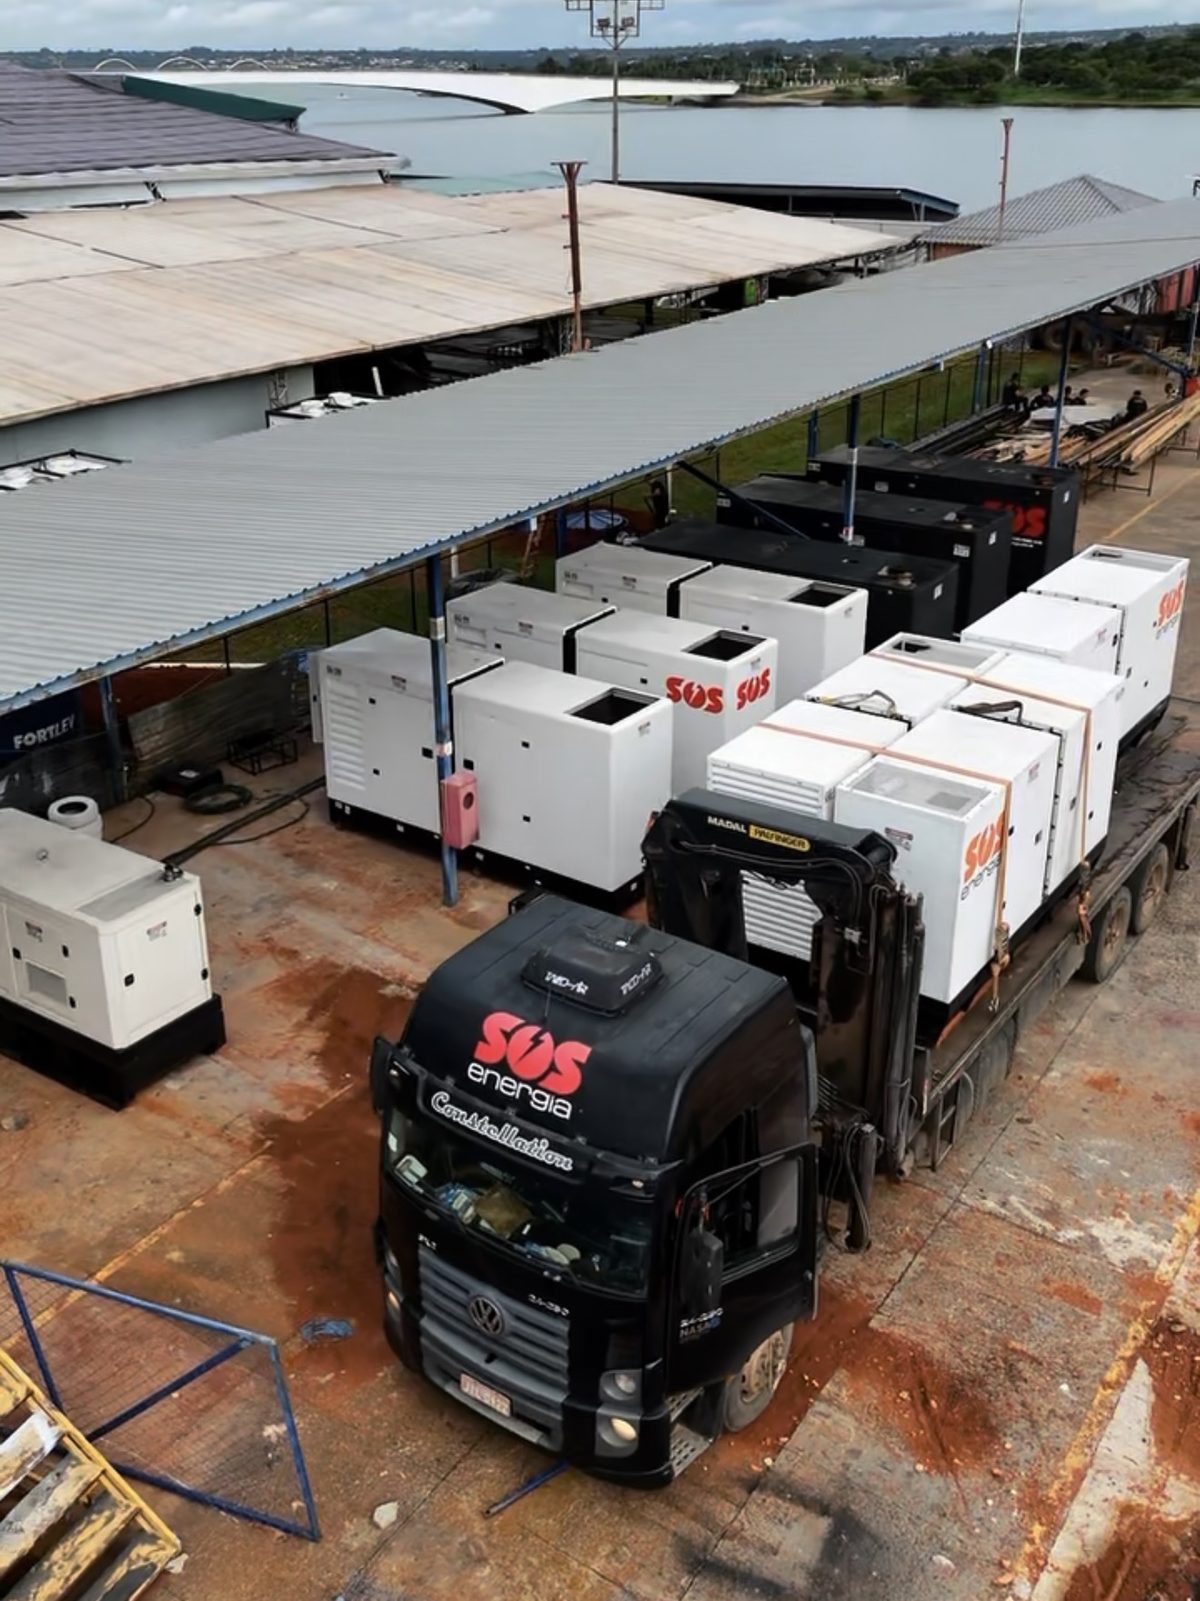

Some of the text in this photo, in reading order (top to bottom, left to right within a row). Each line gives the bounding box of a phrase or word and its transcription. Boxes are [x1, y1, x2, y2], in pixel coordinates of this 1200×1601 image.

[665, 676, 723, 713] SOS
[737, 668, 770, 710] SOS
[707, 816, 747, 834] MADAL
[474, 1011, 592, 1096] SOS
[467, 1062, 572, 1120] energia
[431, 1091, 573, 1171] Constellation
